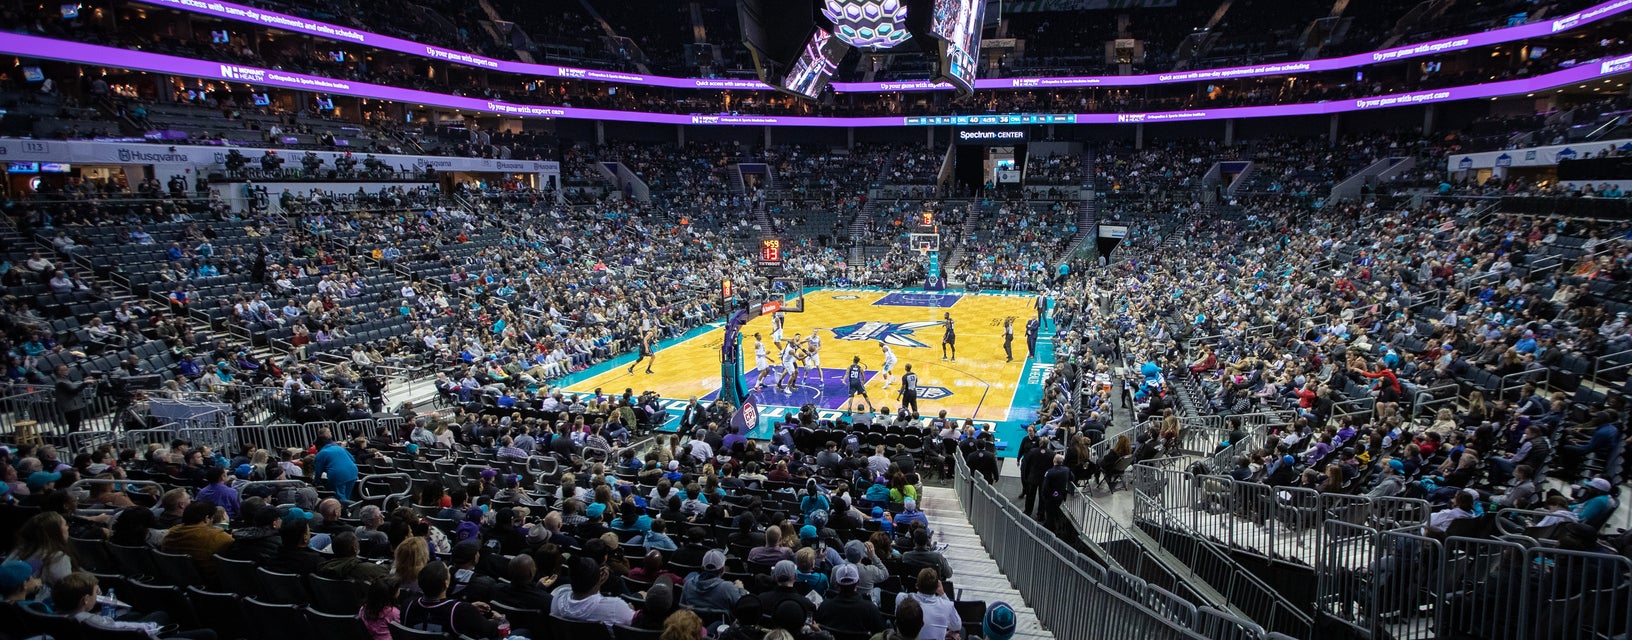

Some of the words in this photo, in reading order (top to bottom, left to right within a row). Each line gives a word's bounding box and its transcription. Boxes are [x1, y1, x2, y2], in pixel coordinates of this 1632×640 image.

[207, 3, 225, 12] with
[225, 7, 259, 20] same-day
[260, 13, 304, 28] appointments
[304, 23, 316, 31] and
[317, 25, 334, 34] online
[335, 29, 364, 41] scheduling
[426, 46, 435, 56] Up
[1373, 53, 1382, 61] Up
[1383, 50, 1396, 60] your
[1397, 49, 1414, 58] game
[1414, 44, 1429, 53] with
[1429, 41, 1451, 52] expert
[1452, 39, 1469, 47] care
[1221, 68, 1254, 76] appointments
[1282, 63, 1310, 71] scheduling
[239, 73, 264, 82] HEALTH
[1357, 99, 1365, 108] Up
[1366, 98, 1379, 107] your
[1380, 96, 1397, 106] game
[1397, 94, 1412, 103] with
[1412, 92, 1434, 103] expert
[1434, 91, 1450, 99] care
[488, 102, 495, 111] Up
[960, 130, 994, 140] Spectrum
[997, 131, 1024, 139] CENTER
[27, 143, 43, 151] 113
[132, 150, 188, 163] Husqvarna
[764, 240, 779, 248] 4:59
[766, 248, 778, 260] 13
[850, 371, 859, 379] 20
[744, 410, 756, 421] CPI
